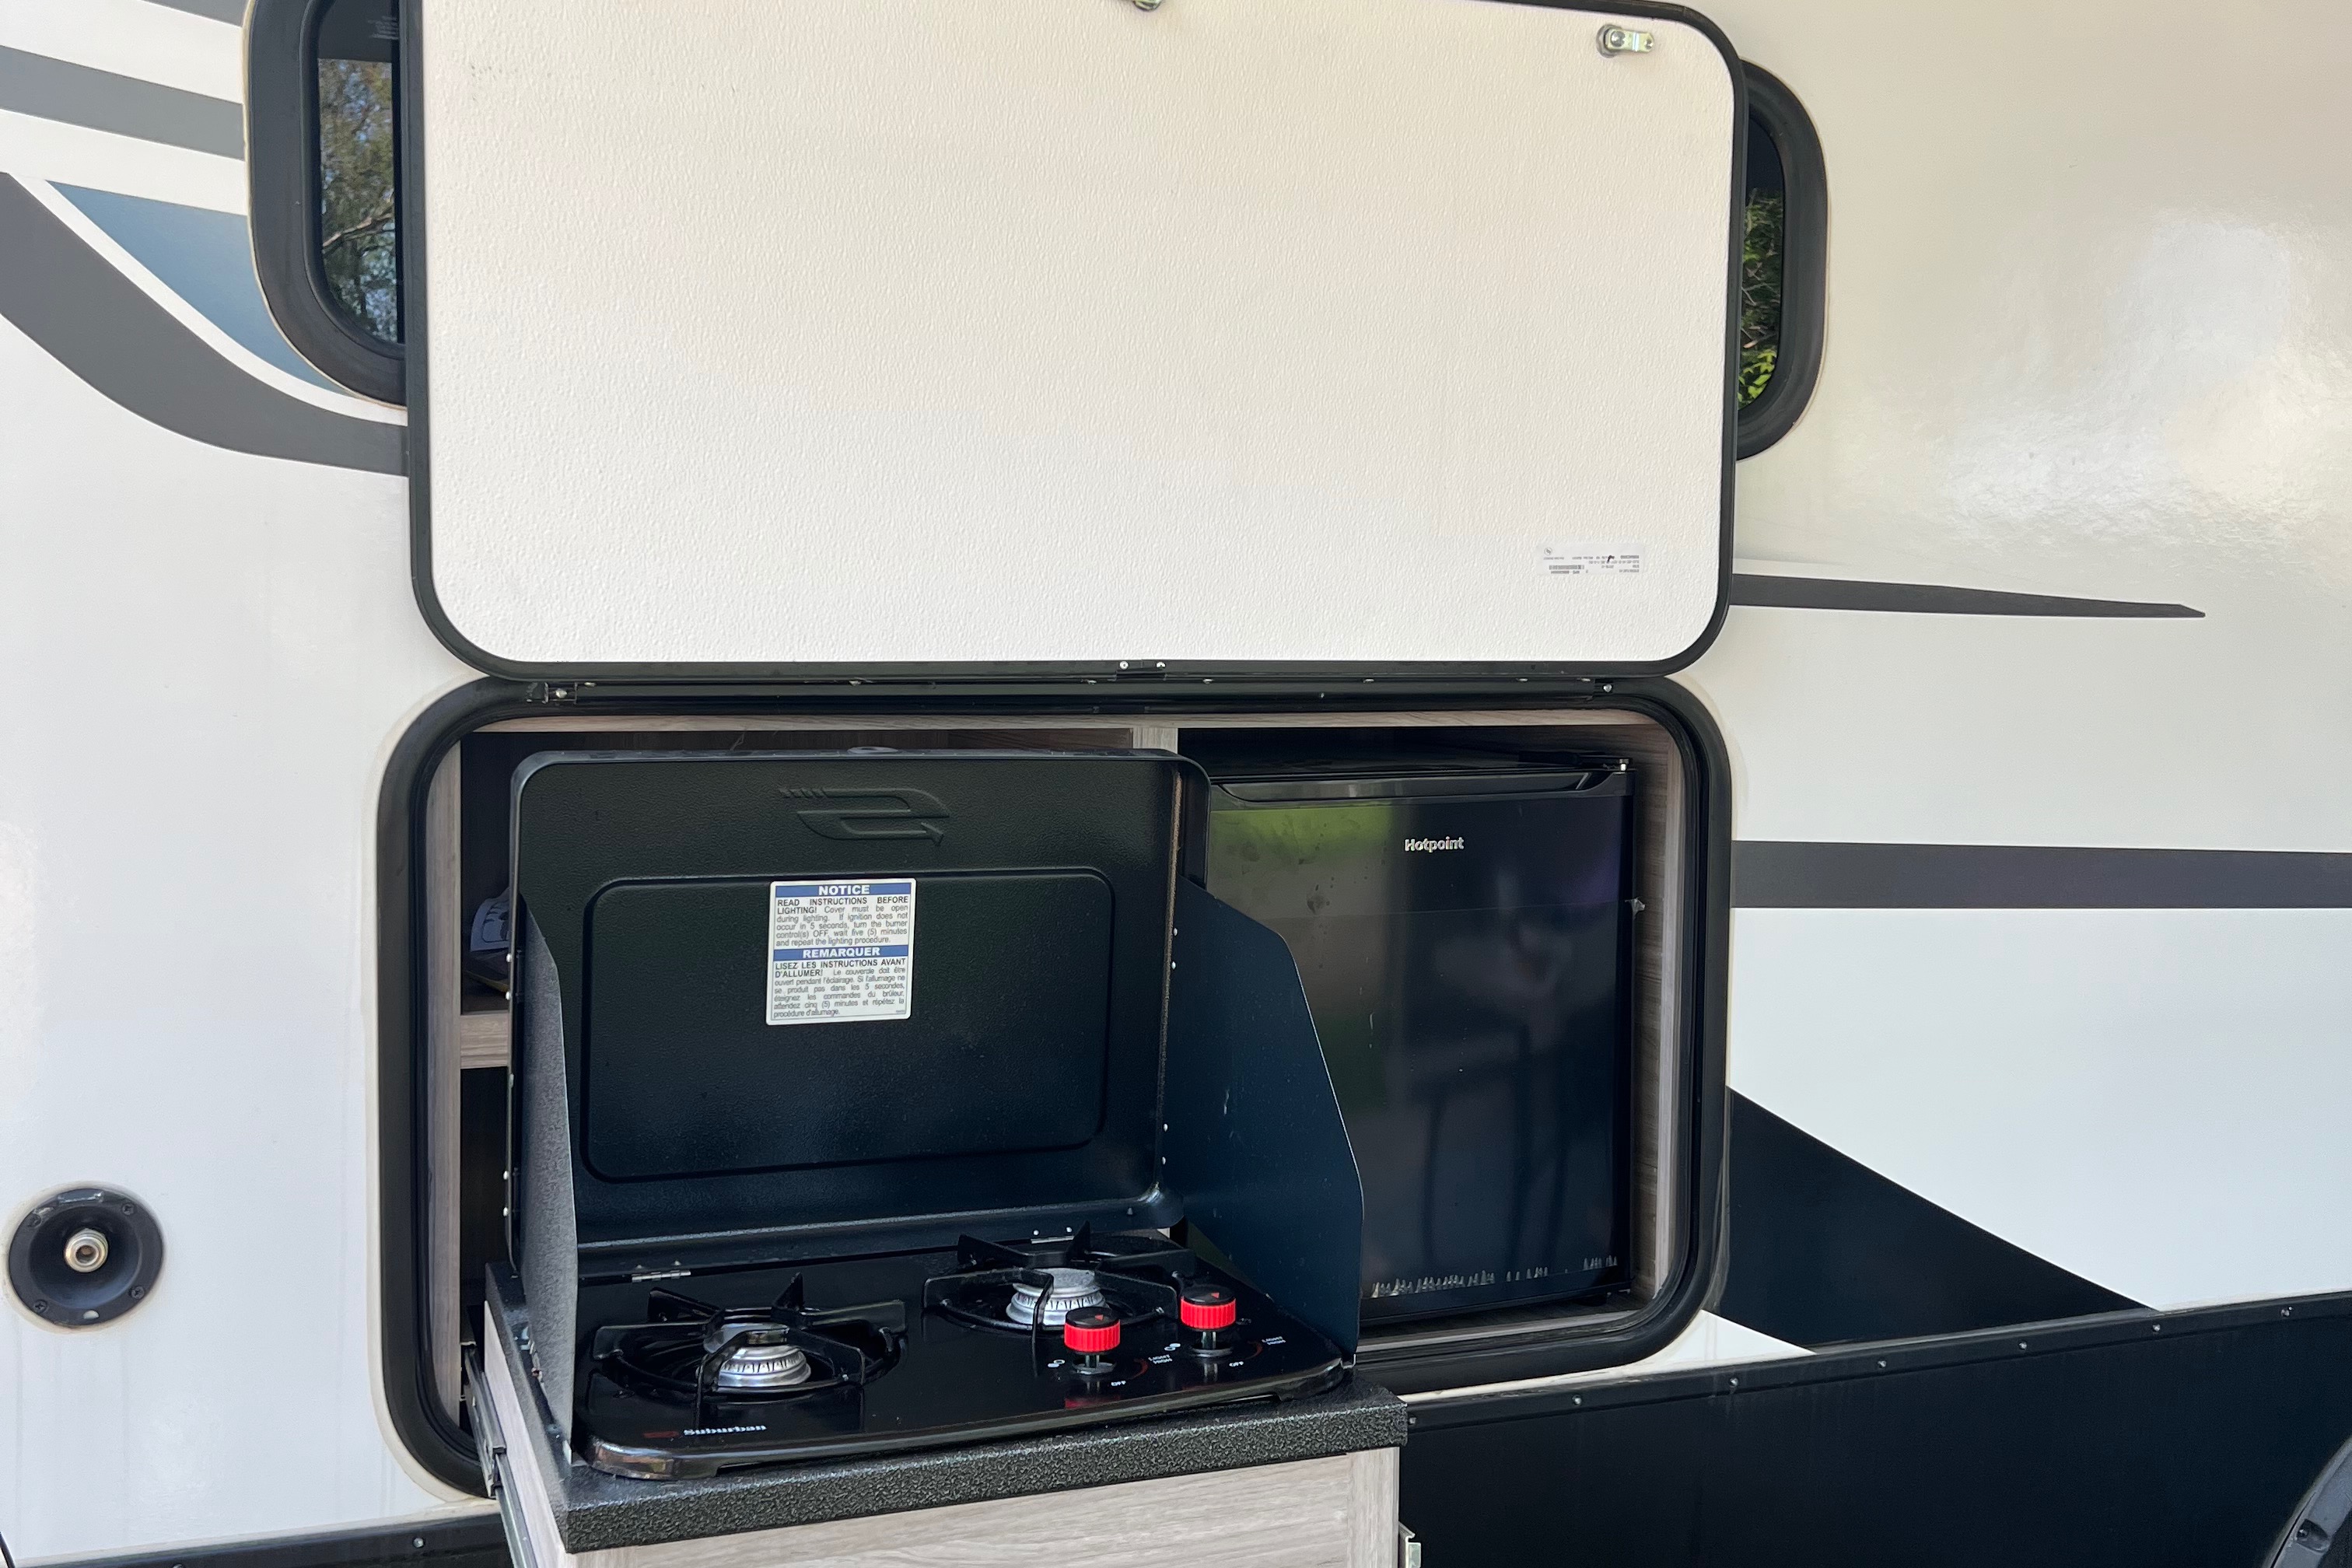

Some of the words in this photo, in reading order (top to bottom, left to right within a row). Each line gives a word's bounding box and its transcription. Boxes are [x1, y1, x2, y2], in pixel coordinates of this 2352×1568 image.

[1405, 836, 1464, 852] Hotpoint
[819, 885, 870, 895] NOTICE
[810, 897, 867, 905] INSTRUCTIONS
[777, 915, 798, 924] during
[848, 913, 872, 922] ignition
[819, 921, 849, 929] seconds,
[776, 930, 809, 939] control(s)
[867, 928, 877, 936] (5)
[828, 936, 852, 946] lighting
[803, 947, 880, 958] REMARQUER
[821, 959, 877, 968] INSTRUCTIONS
[684, 1425, 767, 1436] Suburban
